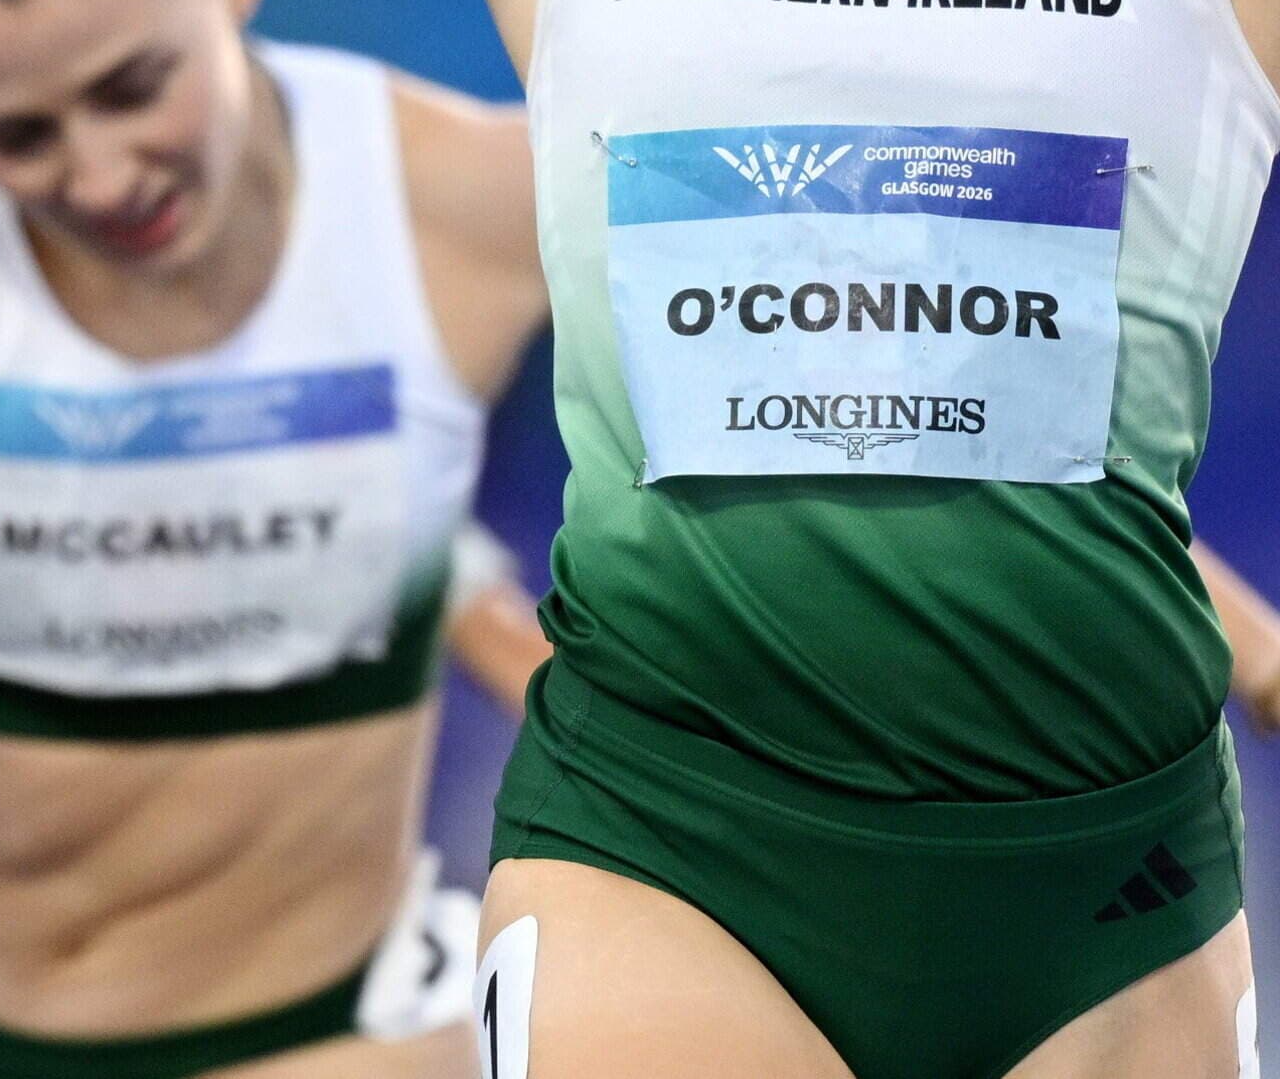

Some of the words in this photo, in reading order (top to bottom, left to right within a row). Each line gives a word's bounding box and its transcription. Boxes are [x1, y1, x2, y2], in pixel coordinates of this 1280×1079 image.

[863, 145, 1016, 166] commonwealth
[903, 160, 973, 179] games
[881, 181, 955, 198] GLASGOW
[956, 185, 993, 201] 2026
[666, 282, 1061, 341] O’CONNOR
[725, 393, 986, 435] LONGINES
[0, 507, 343, 561] MCCAULEY
